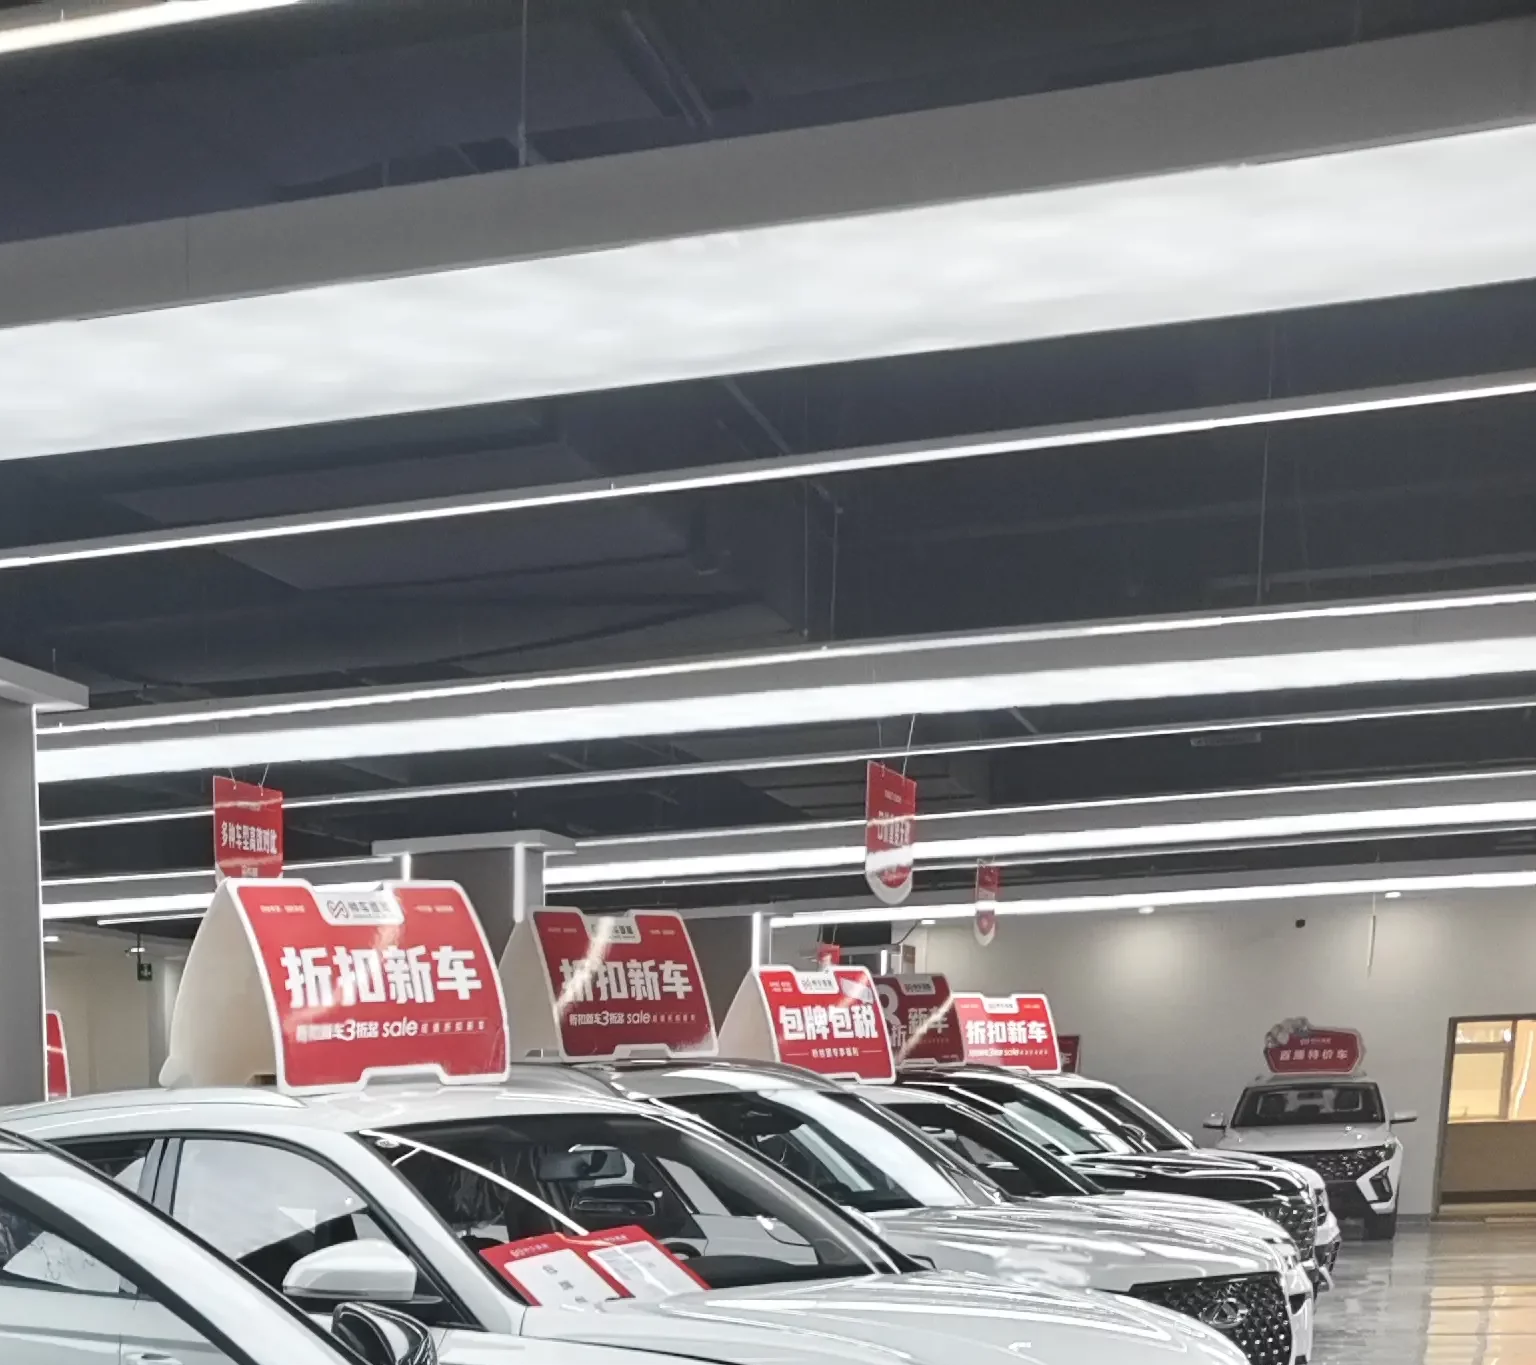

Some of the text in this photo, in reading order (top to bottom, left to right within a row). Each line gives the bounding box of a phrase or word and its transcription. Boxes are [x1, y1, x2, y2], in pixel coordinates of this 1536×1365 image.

[279, 944, 483, 1010] 折扣新车
[559, 958, 694, 1002] 折扣新车
[381, 1016, 418, 1038] sale
[626, 1011, 651, 1025] sale
[778, 1003, 880, 1041] 包牌包税
[964, 1020, 1049, 1045] 折扣新车
